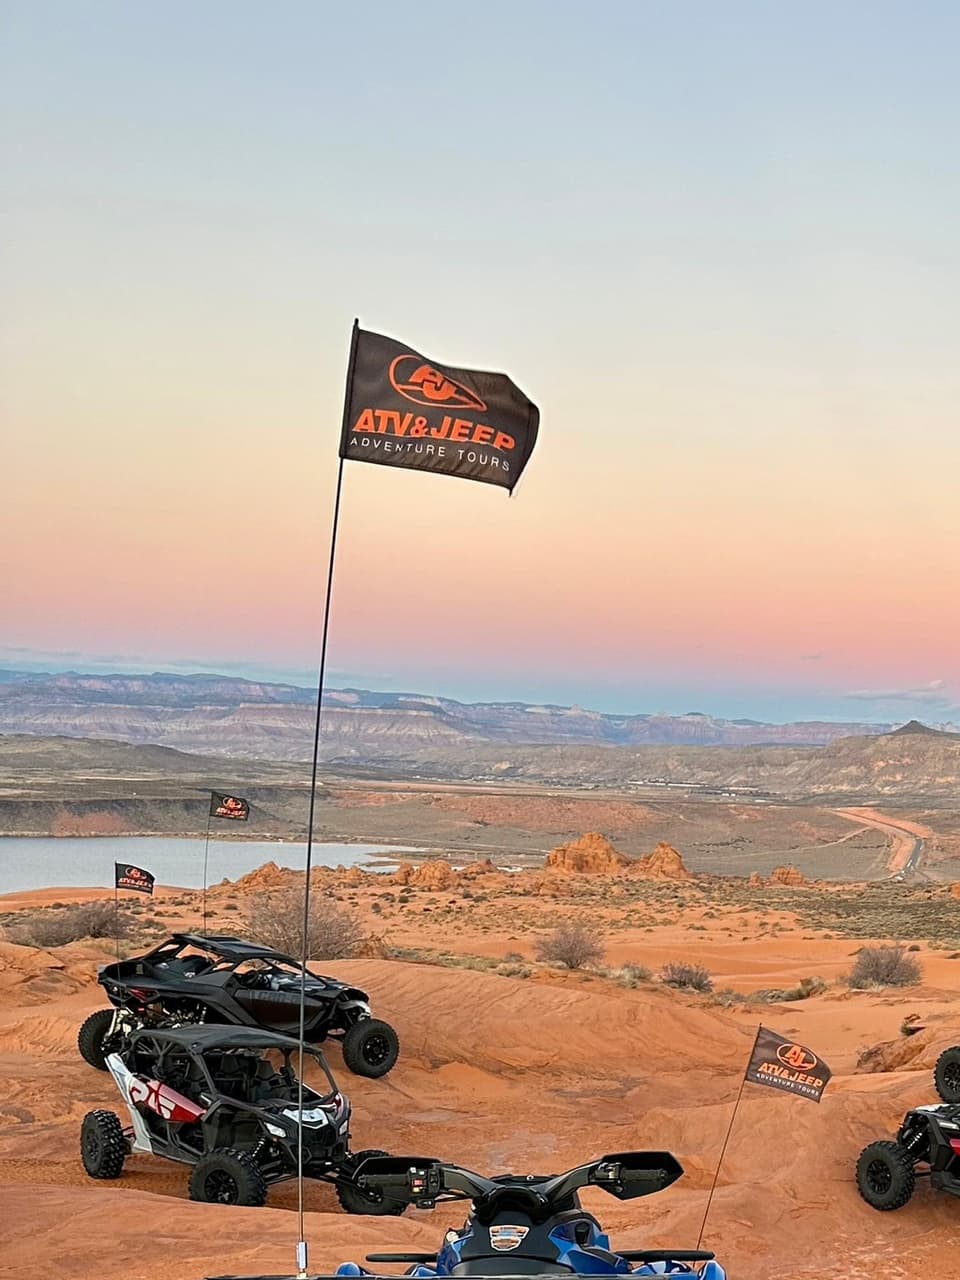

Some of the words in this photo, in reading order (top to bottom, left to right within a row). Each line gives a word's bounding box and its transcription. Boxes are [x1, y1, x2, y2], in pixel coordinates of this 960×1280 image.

[352, 408, 516, 452] ATV&JEEP
[350, 437, 446, 457] ADVENTURE
[458, 450, 510, 472] TOURS
[756, 1073, 795, 1089] ADVENTURE
[758, 1062, 823, 1088] ATV&JEEP
